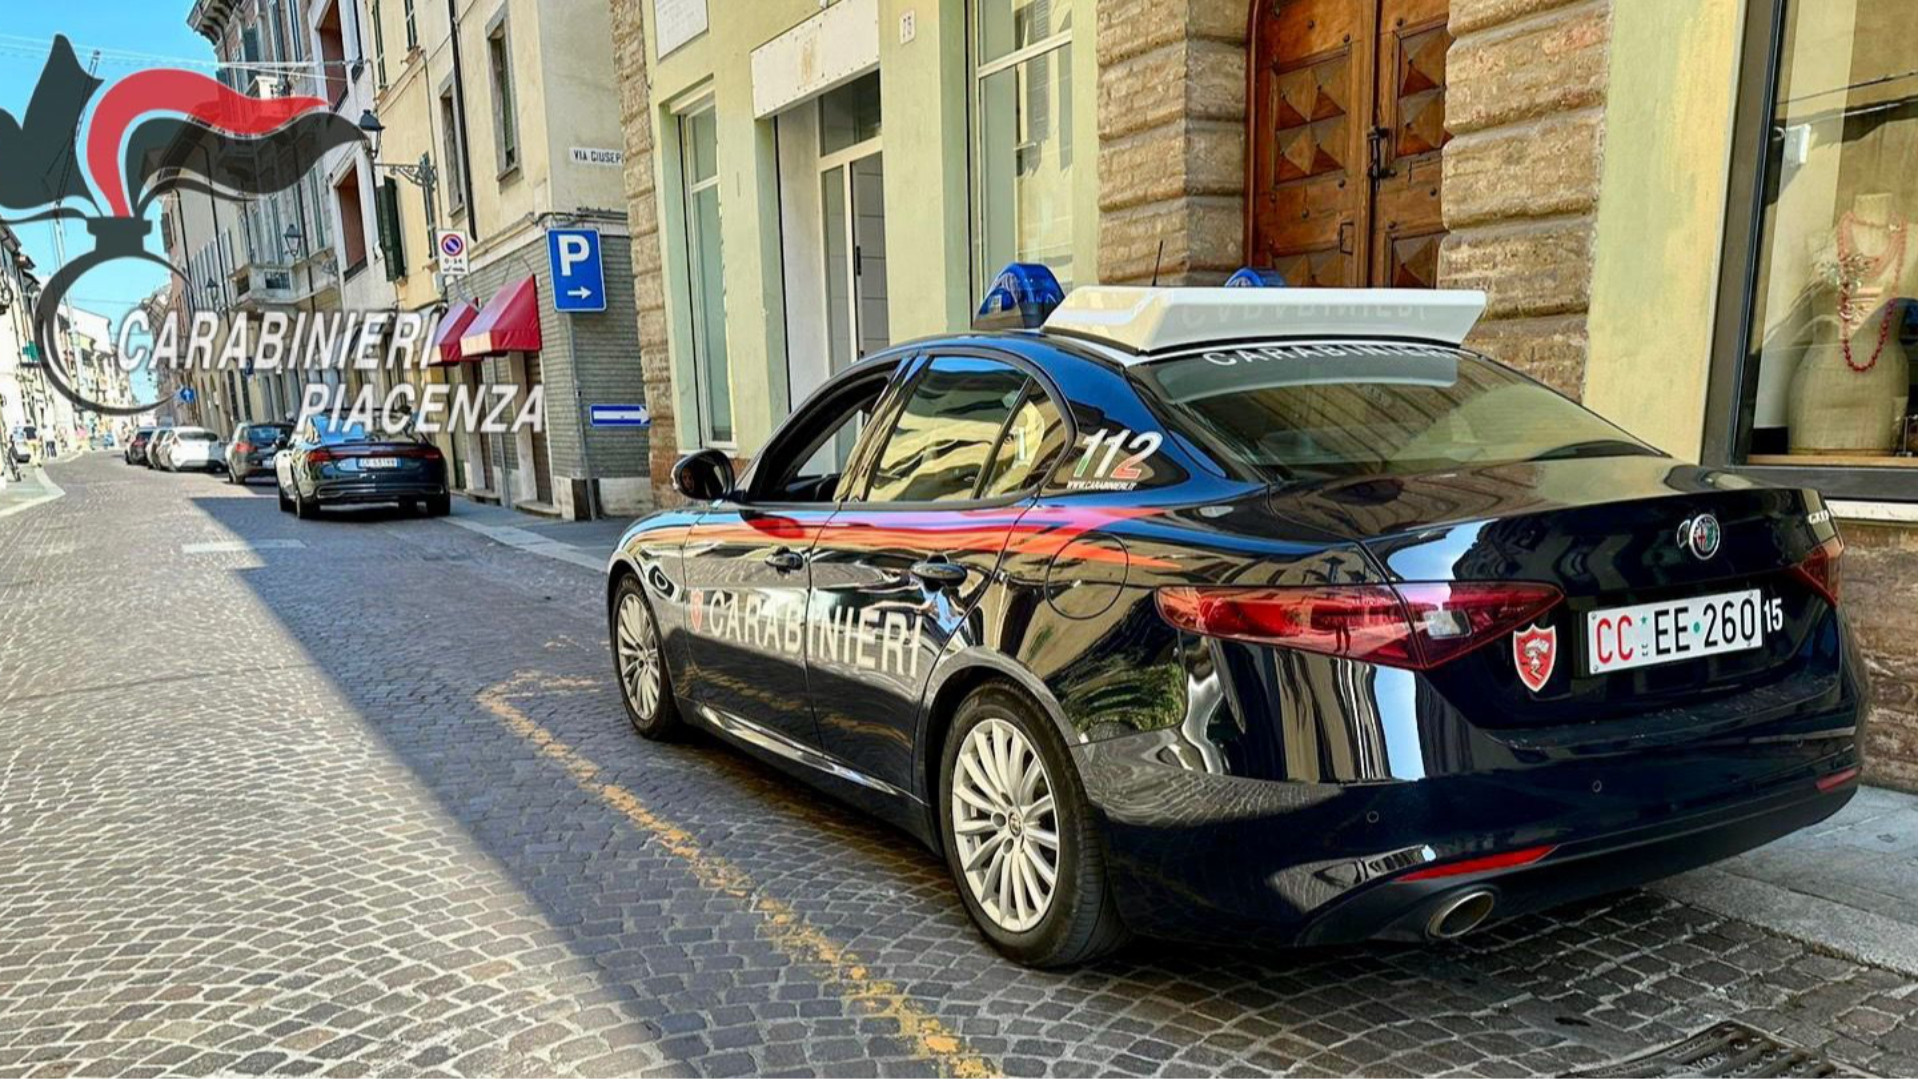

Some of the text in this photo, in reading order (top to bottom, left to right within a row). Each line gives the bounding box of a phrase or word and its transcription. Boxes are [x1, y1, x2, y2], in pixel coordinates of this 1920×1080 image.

[573, 149, 588, 161] VIA
[557, 234, 590, 277] P
[1073, 428, 1163, 479] 112
[709, 589, 923, 678] CARABINIERI
[1596, 598, 1755, 664] CC EE 260
[1763, 597, 1783, 634] 15
